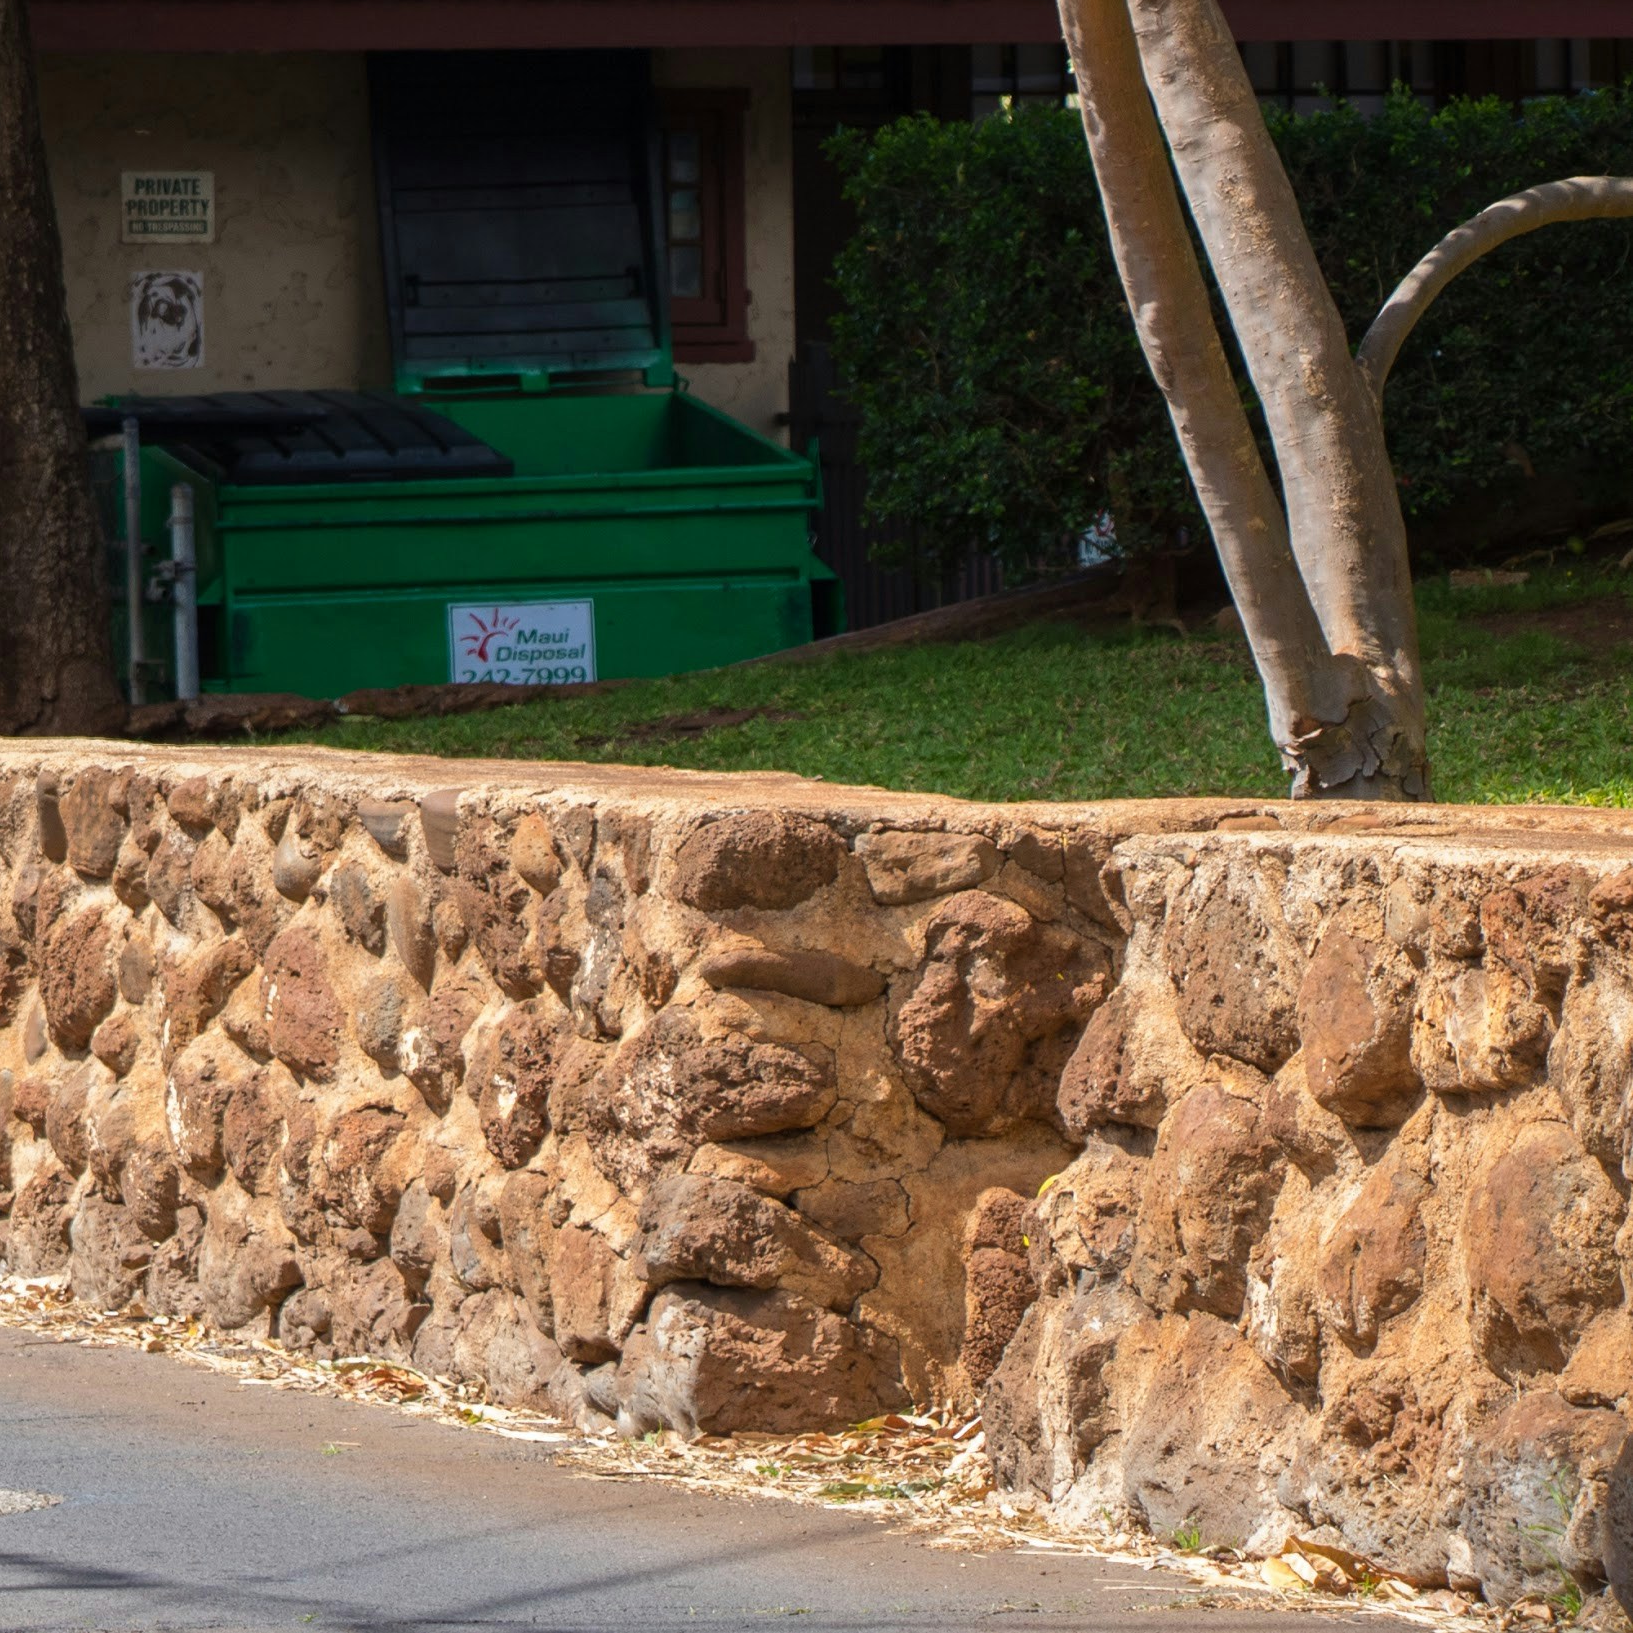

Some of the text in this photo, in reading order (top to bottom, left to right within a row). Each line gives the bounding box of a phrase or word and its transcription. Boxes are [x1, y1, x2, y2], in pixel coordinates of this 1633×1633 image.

[135, 178, 201, 196] PRIVATE
[126, 198, 210, 217] PROPERTY
[132, 222, 205, 233] NO TRESPASSING
[516, 628, 570, 645] Maui
[495, 643, 586, 664] Disposal
